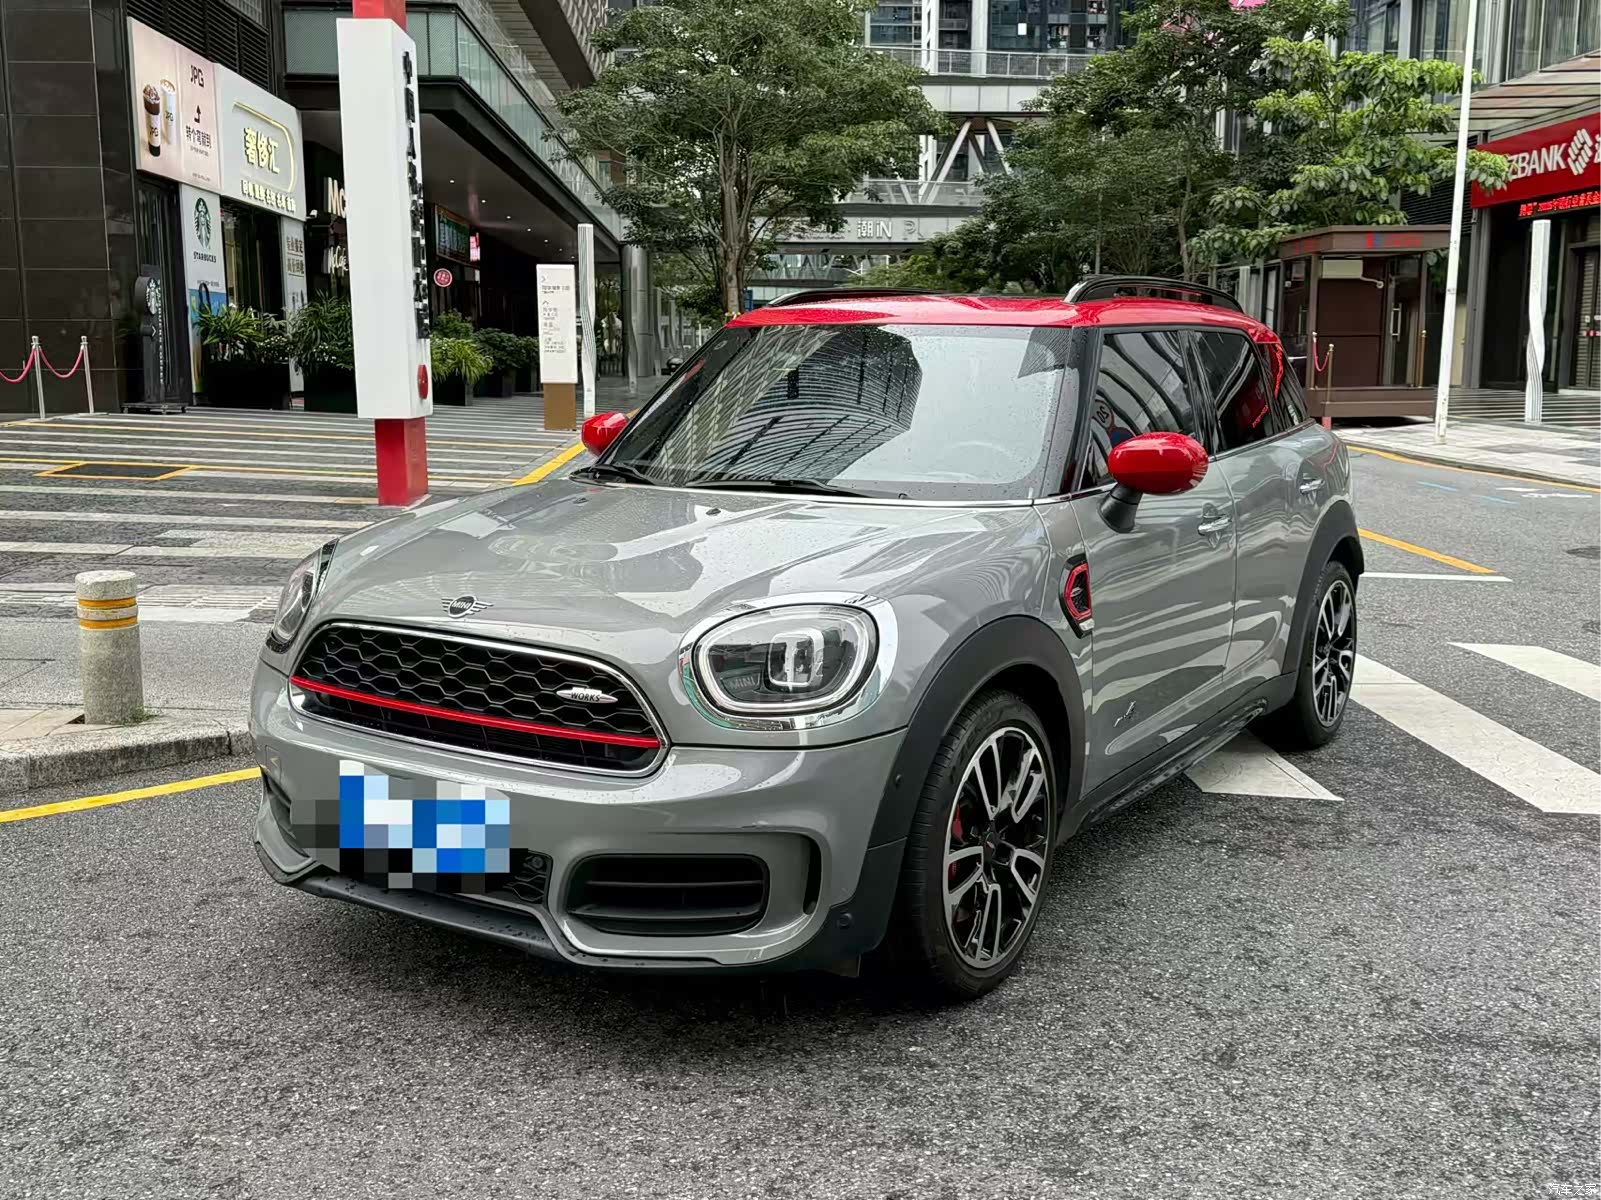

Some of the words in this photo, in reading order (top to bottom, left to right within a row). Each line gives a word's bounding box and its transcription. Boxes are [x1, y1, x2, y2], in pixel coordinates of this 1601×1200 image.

[190, 64, 205, 88] JPG
[193, 250, 217, 264] STARBUCKS
[451, 600, 472, 610] MINI
[571, 692, 601, 702] WORKS
